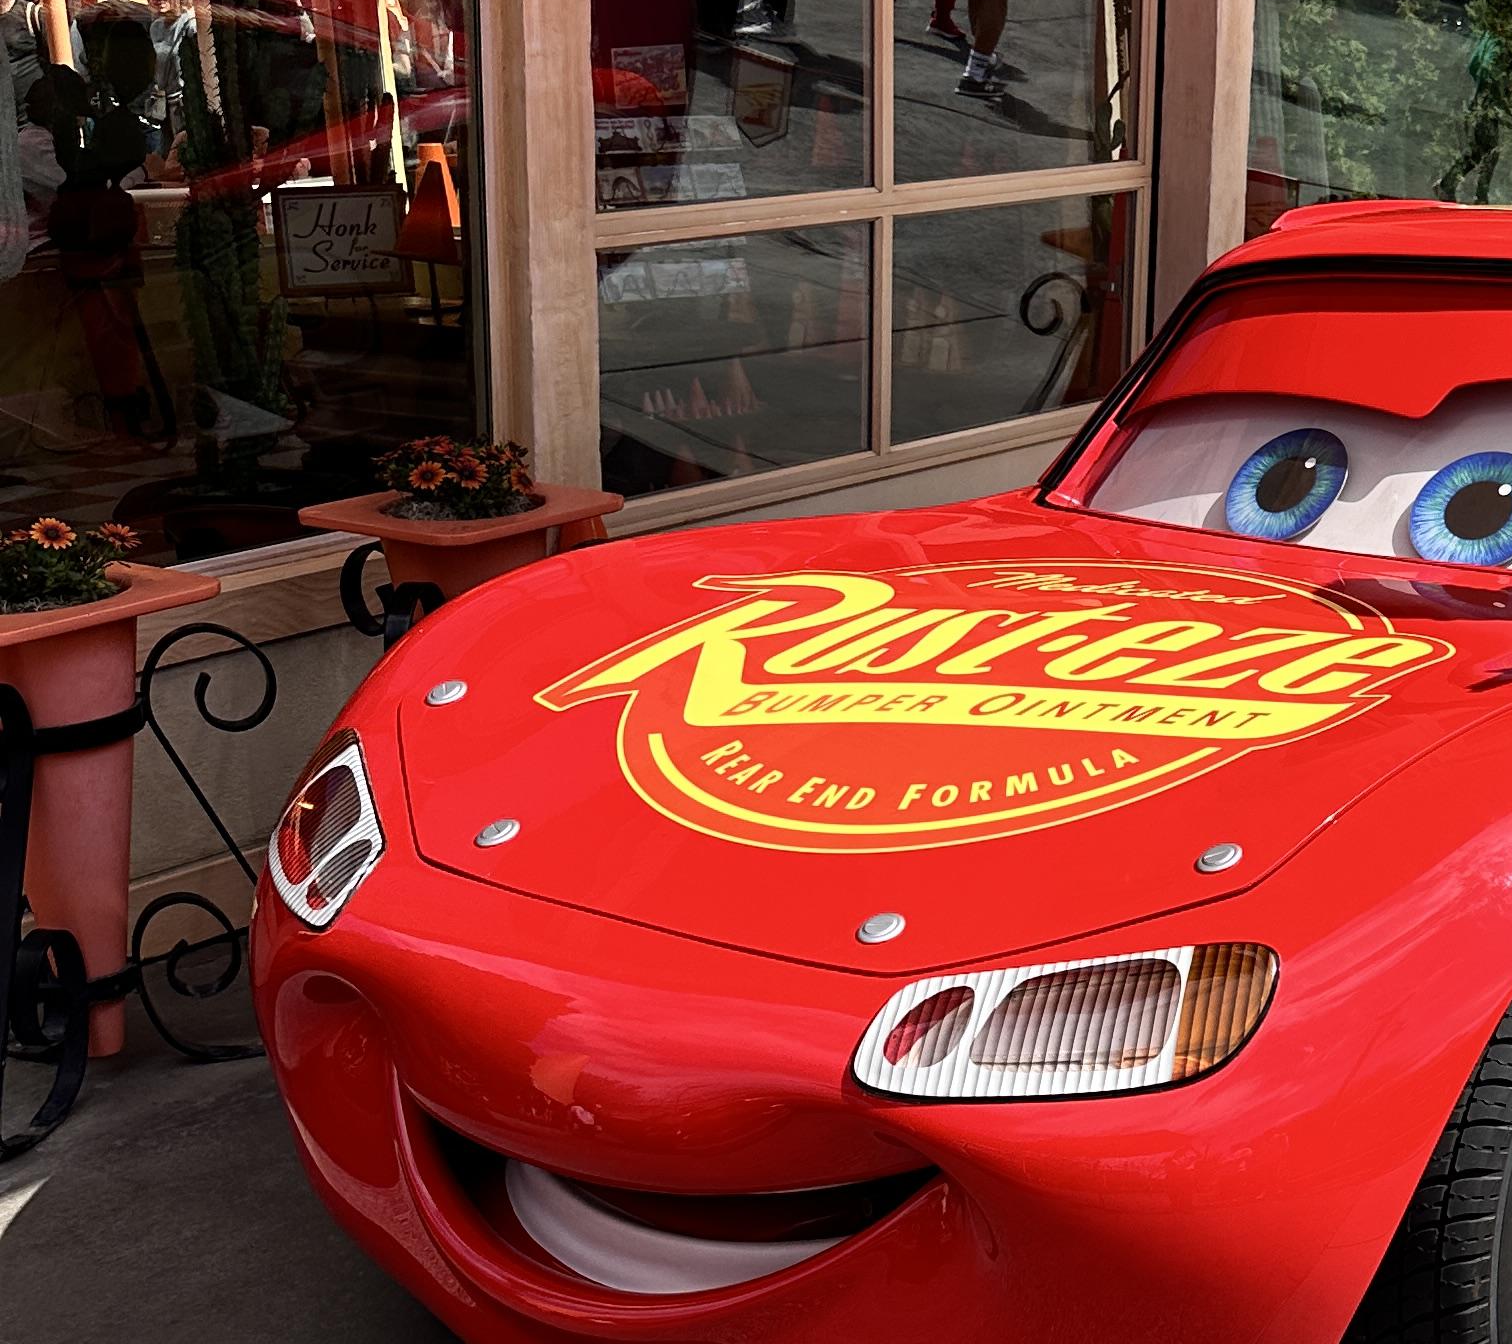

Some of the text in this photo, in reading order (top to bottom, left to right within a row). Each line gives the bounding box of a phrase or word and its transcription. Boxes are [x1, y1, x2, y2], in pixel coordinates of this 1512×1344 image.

[293, 202, 377, 239] Honk
[303, 240, 391, 273] Service
[966, 570, 1287, 605] Medicated
[720, 690, 1273, 731] BUMPER OINTMENT
[699, 739, 1141, 811] REAR END FORMULA
